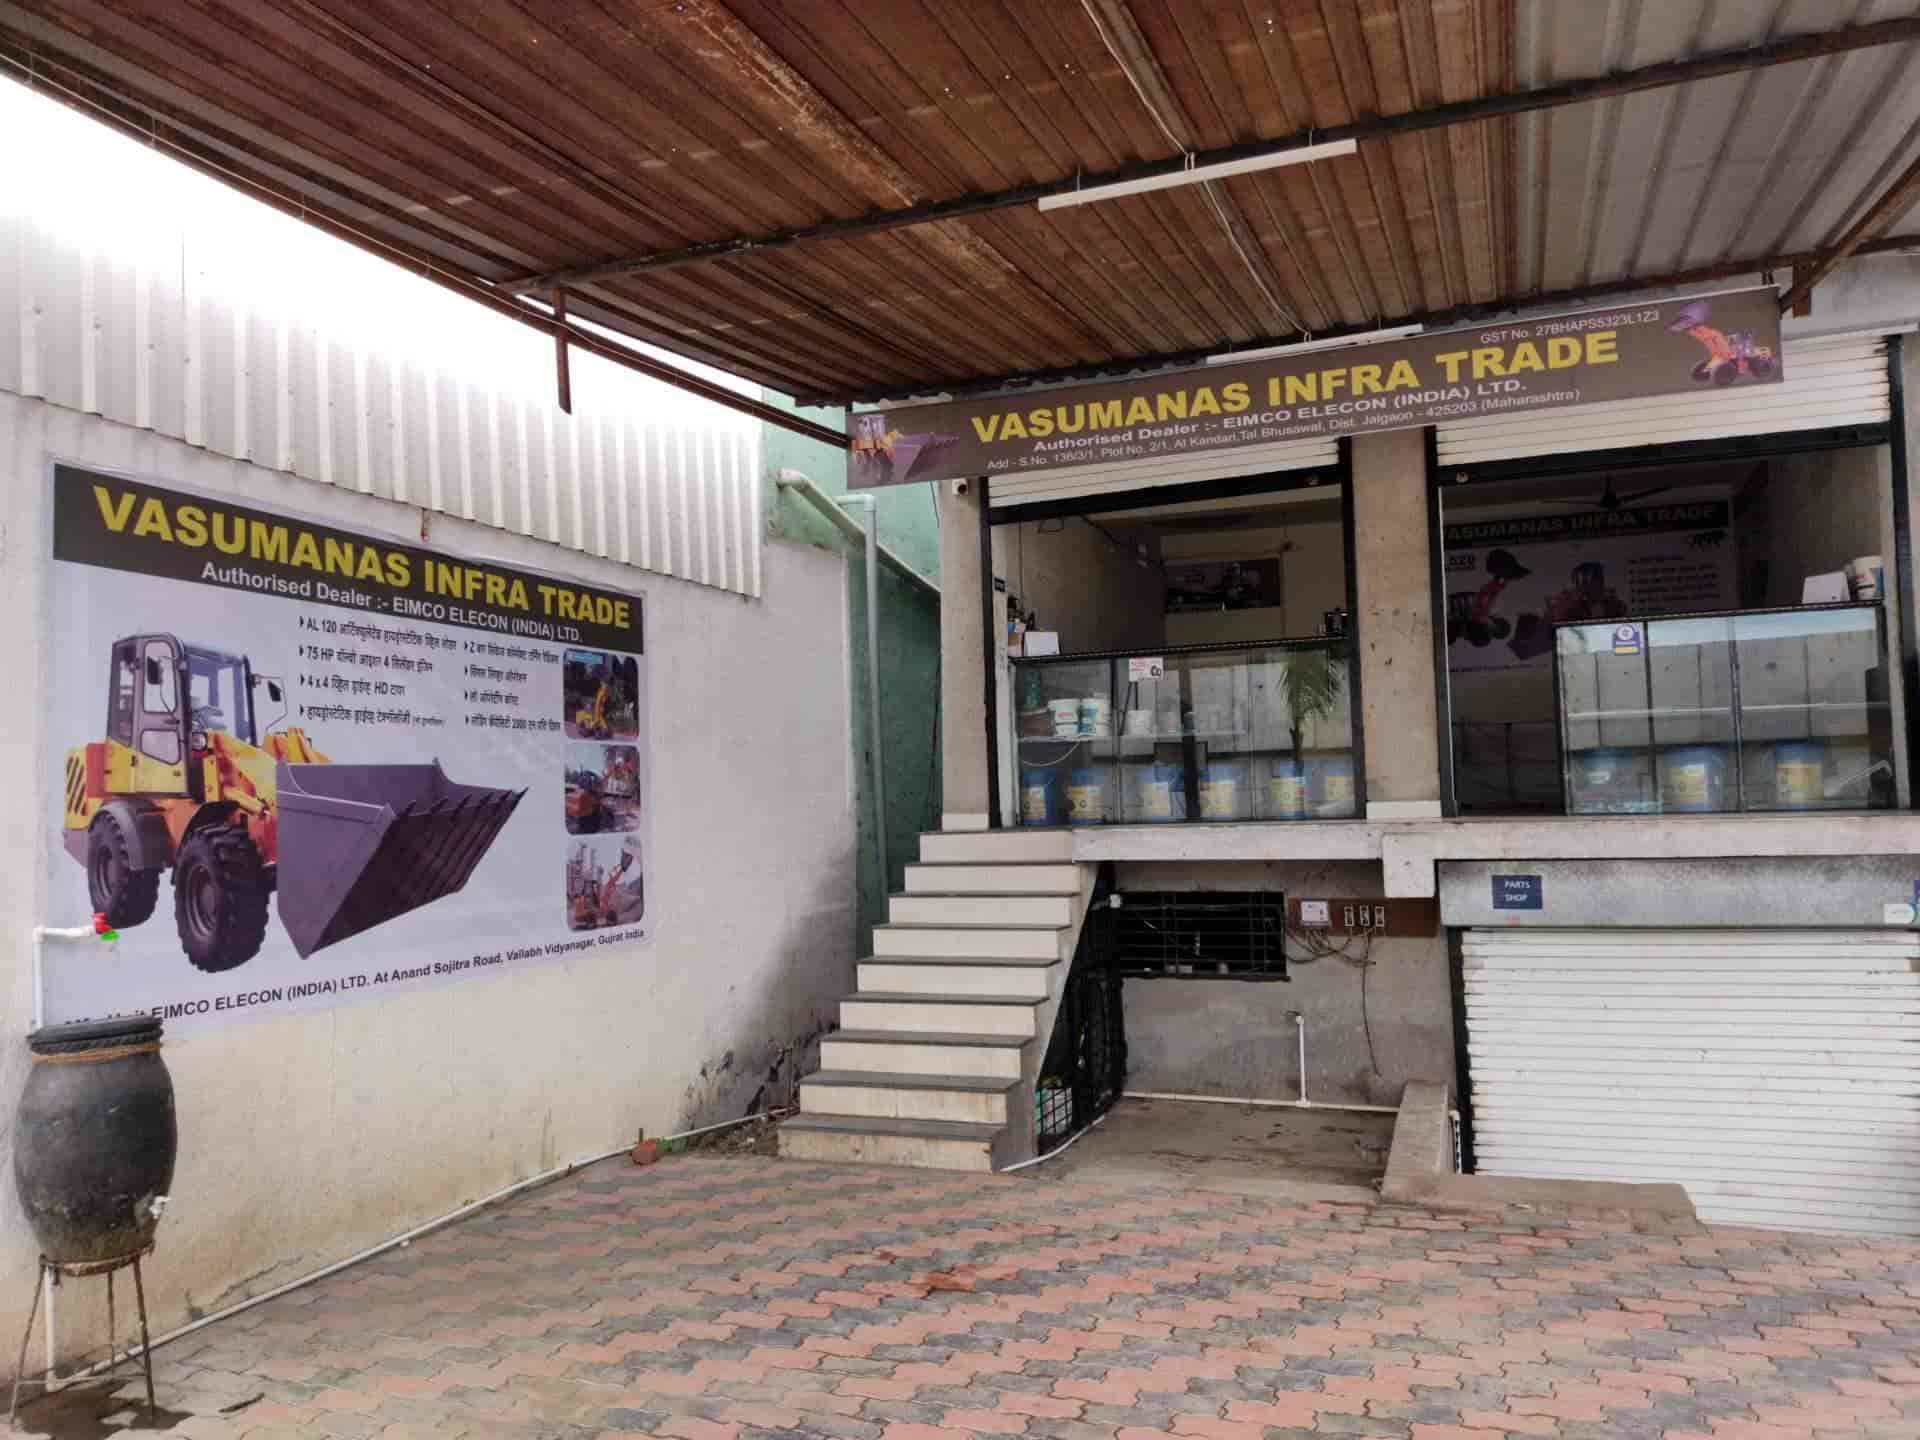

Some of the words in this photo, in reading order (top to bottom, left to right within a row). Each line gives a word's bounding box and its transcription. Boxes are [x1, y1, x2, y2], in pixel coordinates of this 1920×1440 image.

[1480, 331, 1507, 344] GST
[971, 382, 1250, 443] VASUMANAS
[1268, 359, 1420, 406] INFRA
[1435, 331, 1618, 383] TRADE
[1034, 431, 1133, 452] Authorised
[1139, 423, 1199, 440] Dealer
[1223, 411, 1290, 429] EIMCO
[1297, 397, 1387, 418] ELECON
[1394, 386, 1470, 409] (INDIA)
[1477, 379, 1527, 396] LTD.
[1362, 410, 1413, 427] Jalgaon
[1425, 401, 1477, 418] 425203
[1481, 389, 1581, 411] (Maharashtra)
[93, 486, 410, 588] VASUMANAS
[424, 559, 529, 611] INFRA
[537, 584, 630, 629] TRADE
[201, 561, 311, 597] Authorised
[316, 582, 372, 608] Dealer
[393, 597, 445, 620] EIMCO
[450, 607, 508, 633] ELECON
[511, 618, 554, 640] (INDIA)
[557, 626, 583, 642] LTD.
[306, 618, 319, 632] AL
[322, 620, 337, 633] 120
[306, 646, 319, 660] 75
[321, 648, 334, 662] HP
[374, 681, 389, 696] HD
[1504, 880, 1530, 889] PARTS
[1504, 893, 1528, 902] SHOP
[152, 1000, 209, 1019] EIMCO
[215, 987, 282, 1011] ELECON
[287, 979, 337, 1001] (INDIA)
[341, 974, 370, 990] LTD.
[374, 971, 388, 984] At
[391, 964, 431, 982] Anand
[434, 958, 470, 975] Sojitra
